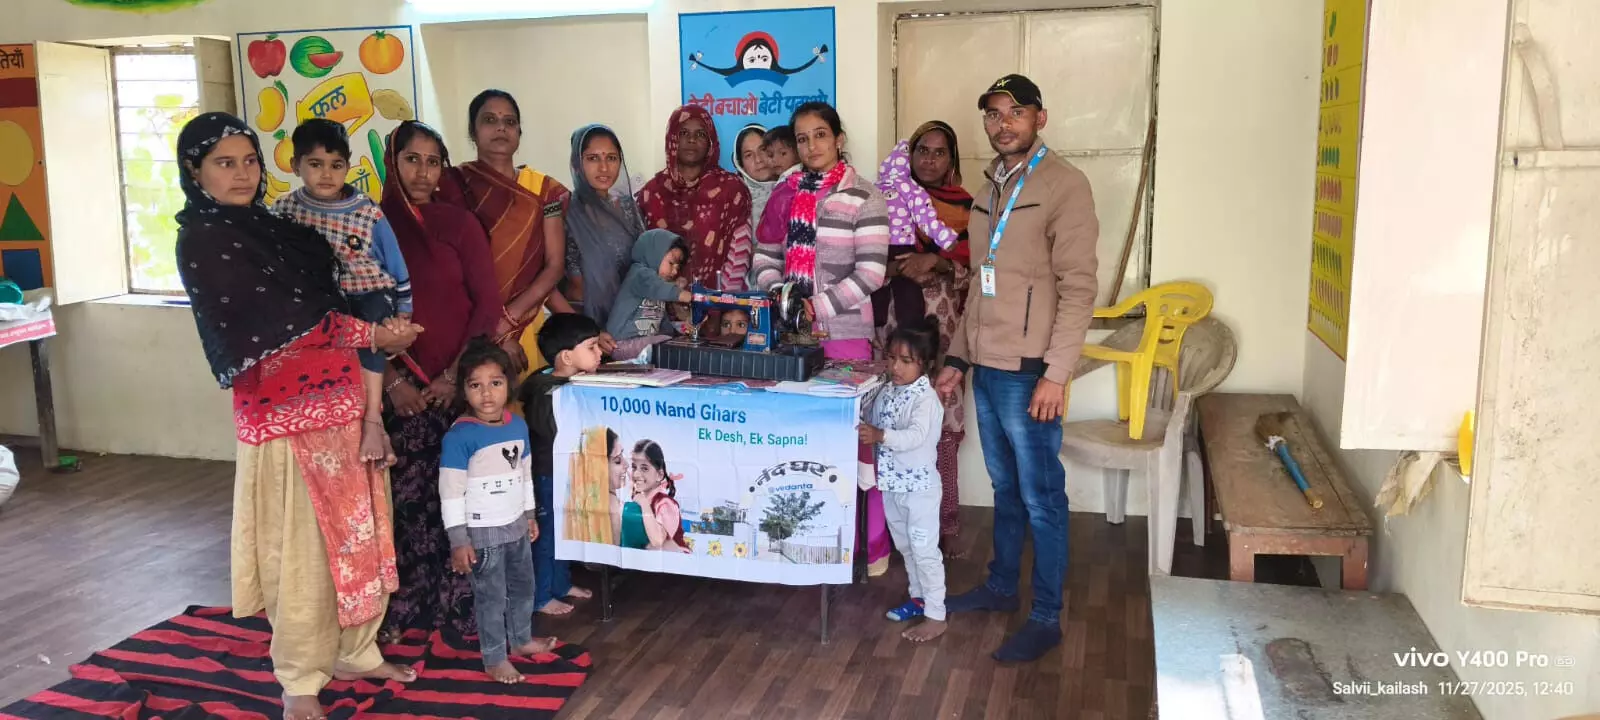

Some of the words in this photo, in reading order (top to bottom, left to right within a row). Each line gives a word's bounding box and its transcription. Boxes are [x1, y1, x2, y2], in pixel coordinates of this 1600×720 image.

[309, 85, 347, 118] फल
[715, 92, 759, 116] बचाओ
[758, 90, 783, 115] बेटी
[600, 395, 651, 416] 10,000
[655, 400, 696, 419] Nand
[700, 403, 747, 424] Ghars
[698, 427, 712, 441] Ek
[715, 429, 747, 446] Desh,
[749, 432, 763, 445] Ek
[767, 433, 808, 448] Sapna!
[775, 483, 813, 492] vedanta
